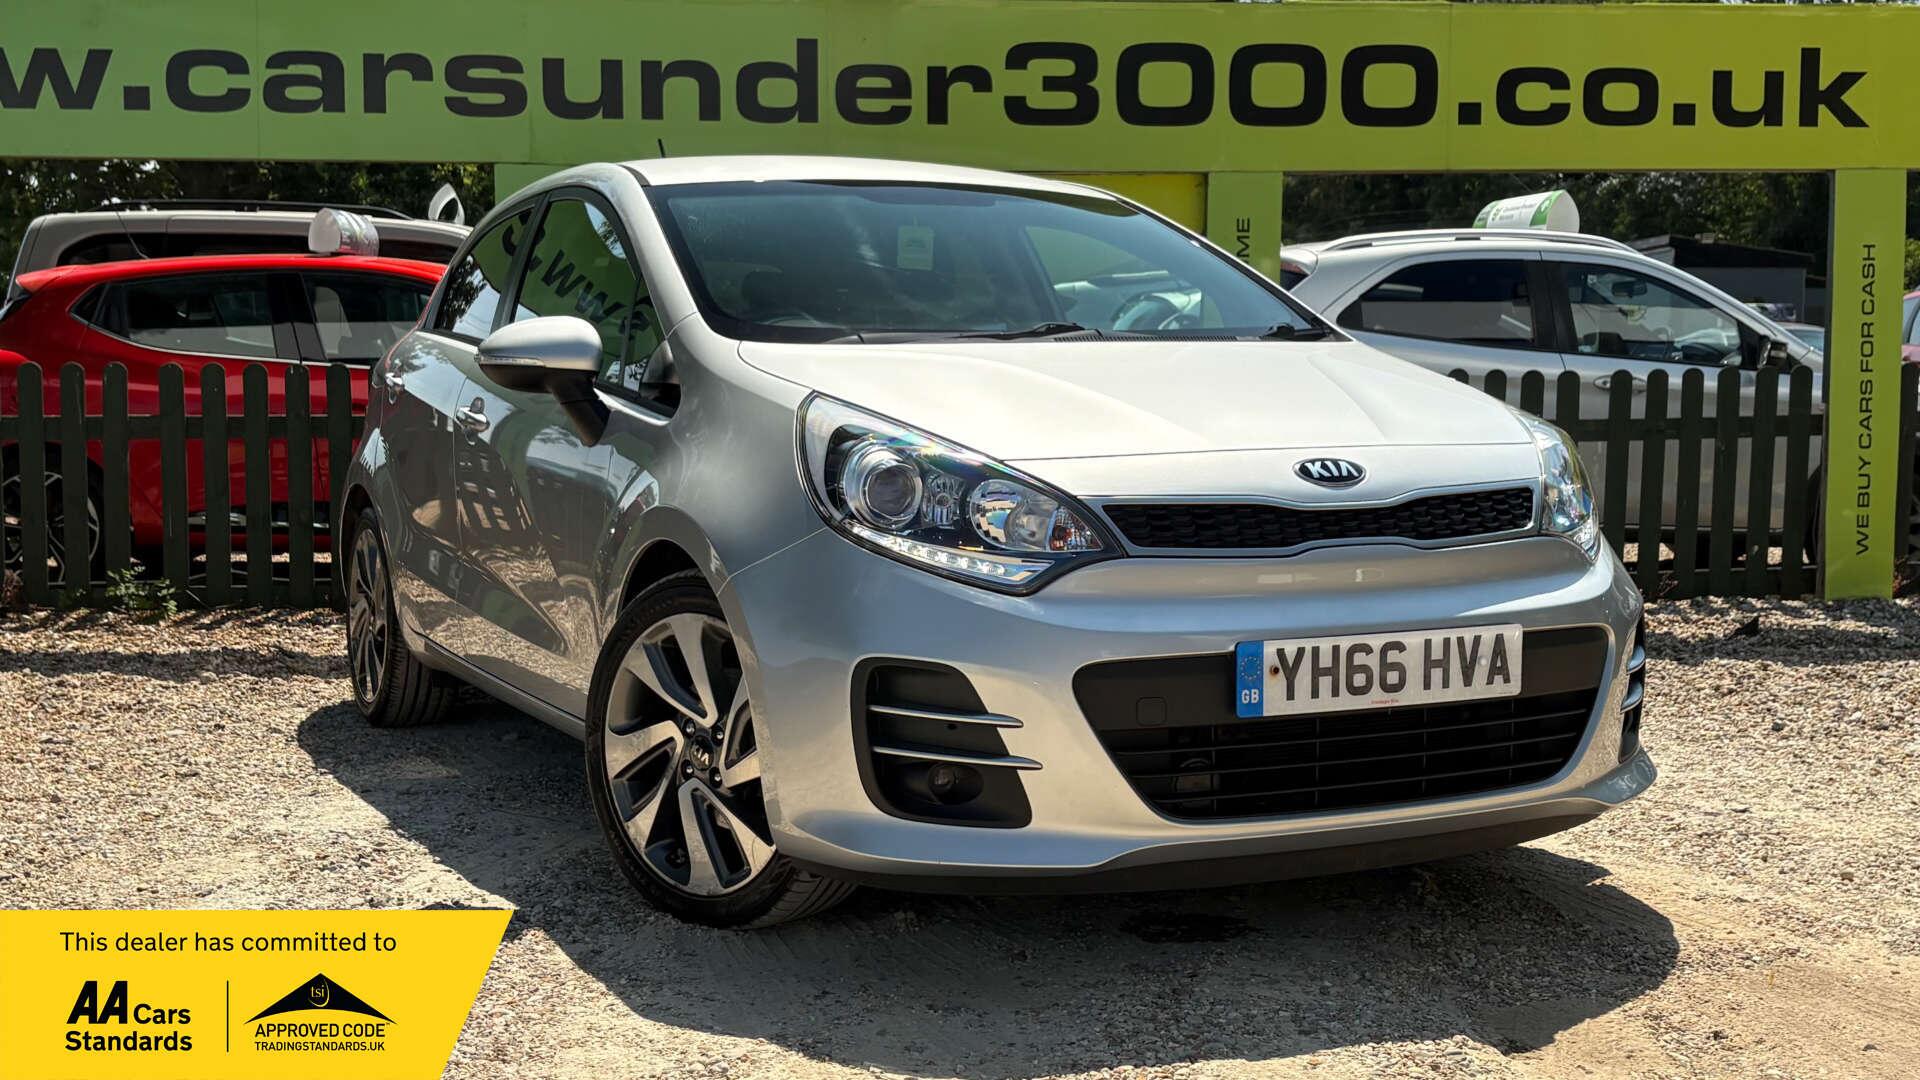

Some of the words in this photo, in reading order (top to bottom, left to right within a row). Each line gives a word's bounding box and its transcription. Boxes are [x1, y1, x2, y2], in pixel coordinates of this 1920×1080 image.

[1236, 217, 1250, 263] ME
[1861, 244, 1877, 316] CASH
[1860, 321, 1875, 373] FOR
[1858, 379, 1874, 450] CARS
[1304, 460, 1359, 478] KIA
[1857, 455, 1872, 508] BUY
[1855, 512, 1870, 556] WE
[1276, 641, 1407, 701] YH66
[1423, 633, 1511, 691] HVA
[1241, 688, 1259, 704] GB
